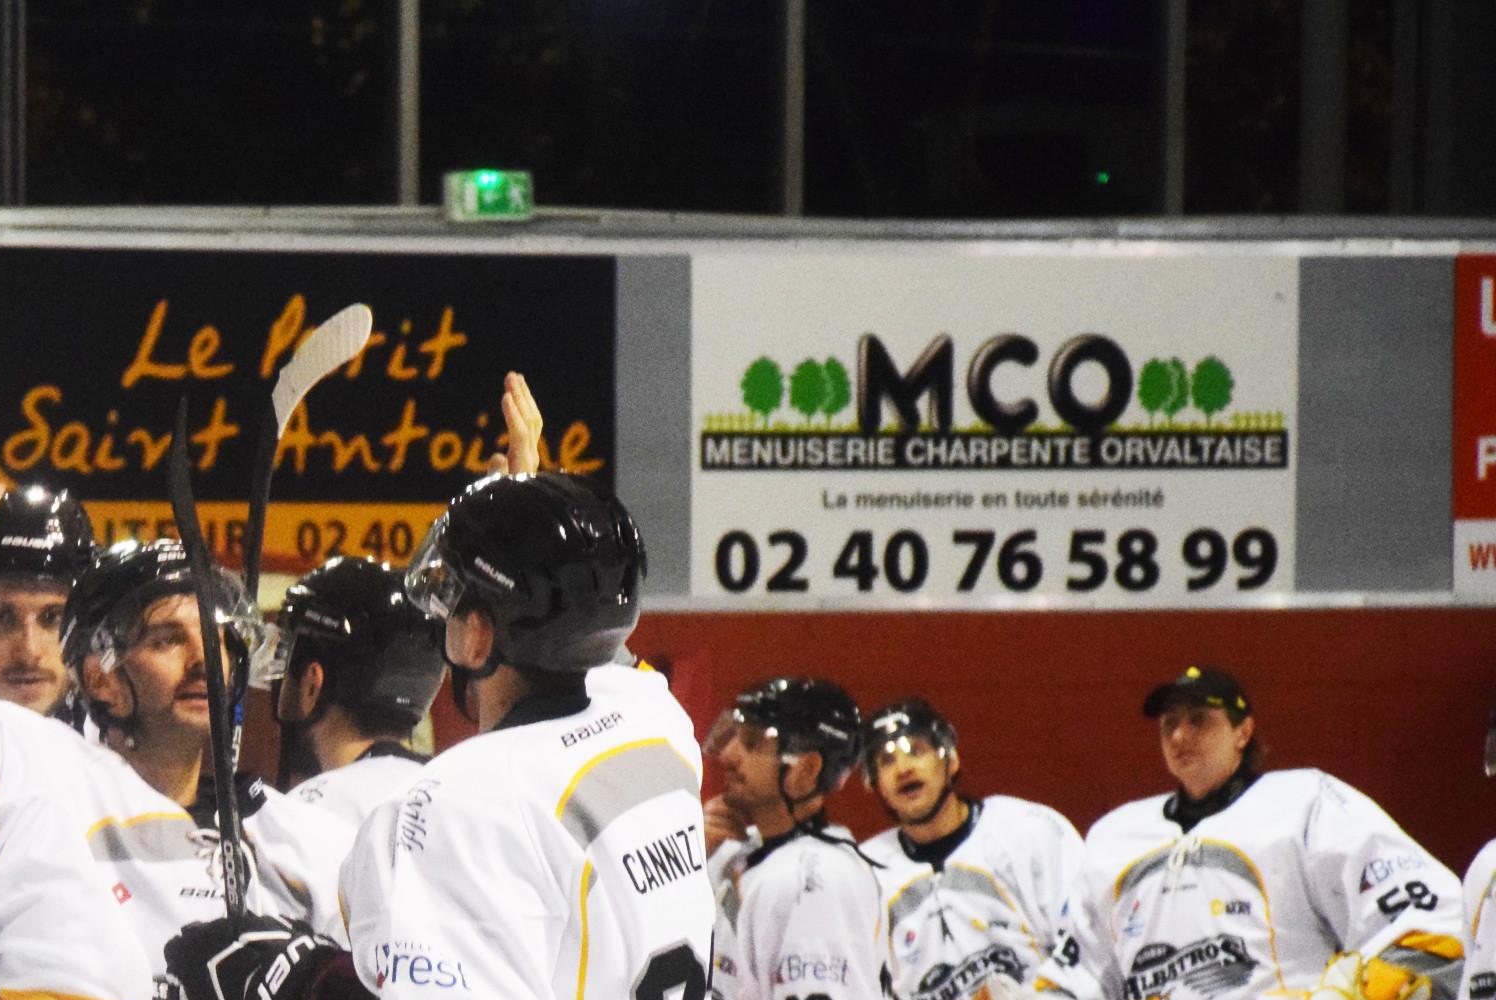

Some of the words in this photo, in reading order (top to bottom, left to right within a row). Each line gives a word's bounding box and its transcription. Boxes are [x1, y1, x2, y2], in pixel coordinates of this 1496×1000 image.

[120, 299, 234, 388] Le
[856, 332, 1134, 433] MCO
[273, 400, 605, 475] Antoie
[705, 436, 896, 468] MENUISERIE
[904, 437, 1092, 466] CHARPENTE
[1100, 437, 1284, 466] ORVALTAISE
[822, 488, 848, 509] La
[854, 488, 974, 510] menuiserie
[981, 494, 1009, 509] en
[1014, 490, 1071, 510] toute
[1077, 487, 1166, 509] sérénité
[296, 521, 347, 557] 02
[361, 520, 414, 555] 40
[713, 528, 810, 594] 02
[832, 528, 930, 593] 40
[952, 528, 1045, 592] 76
[1066, 527, 1161, 591] 58
[1181, 526, 1279, 592] 99
[560, 710, 624, 748] BAUER
